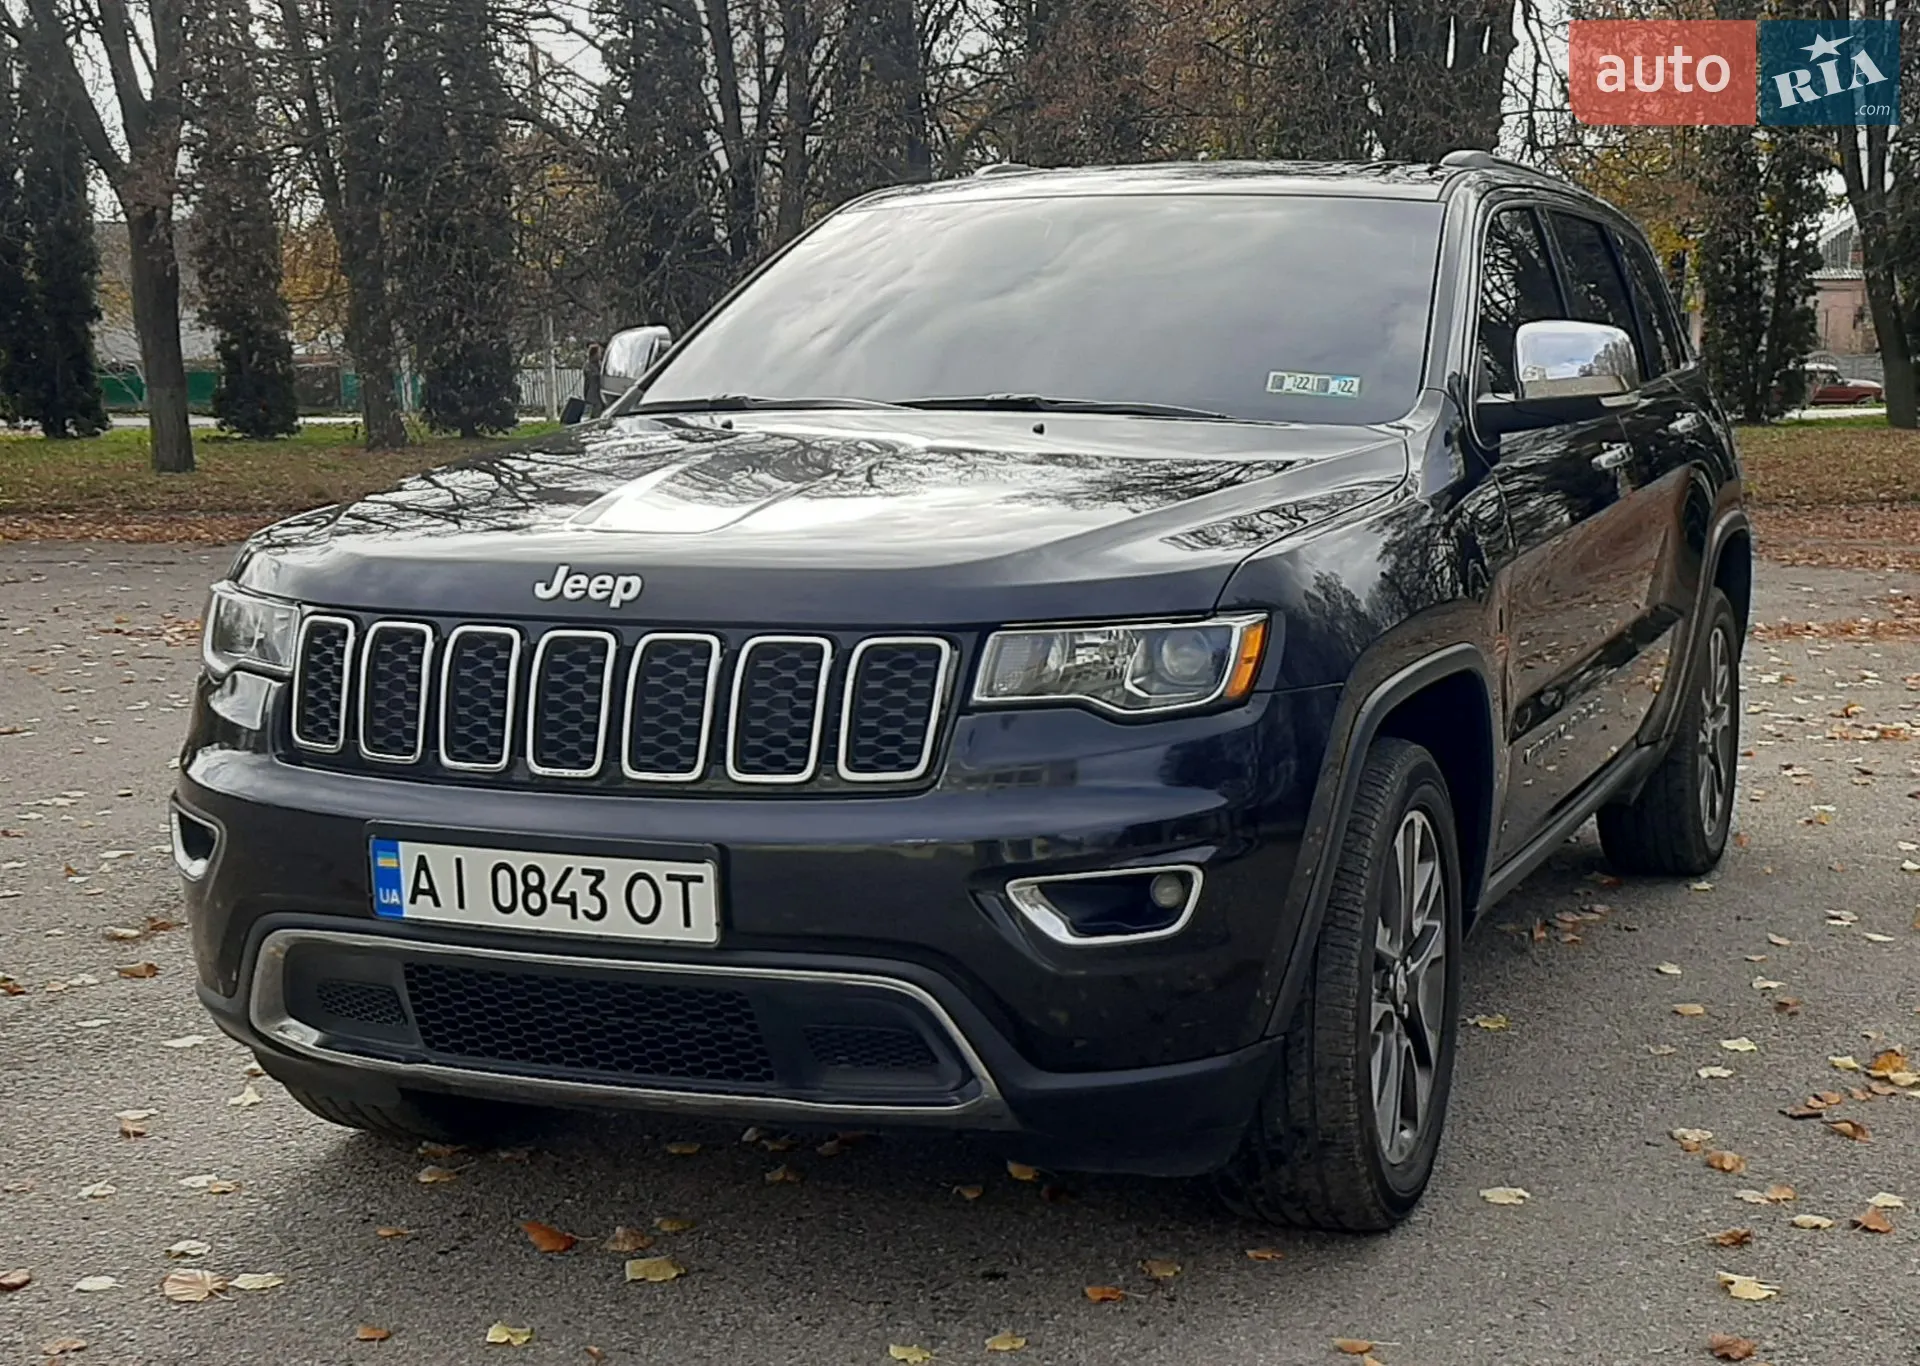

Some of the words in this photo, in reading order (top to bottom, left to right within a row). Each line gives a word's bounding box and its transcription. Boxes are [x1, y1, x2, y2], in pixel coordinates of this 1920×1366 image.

[534, 564, 642, 608] Jeep
[379, 887, 400, 904] UA
[408, 854, 466, 910] AI
[490, 861, 608, 922] 0843
[624, 871, 704, 928] OT
